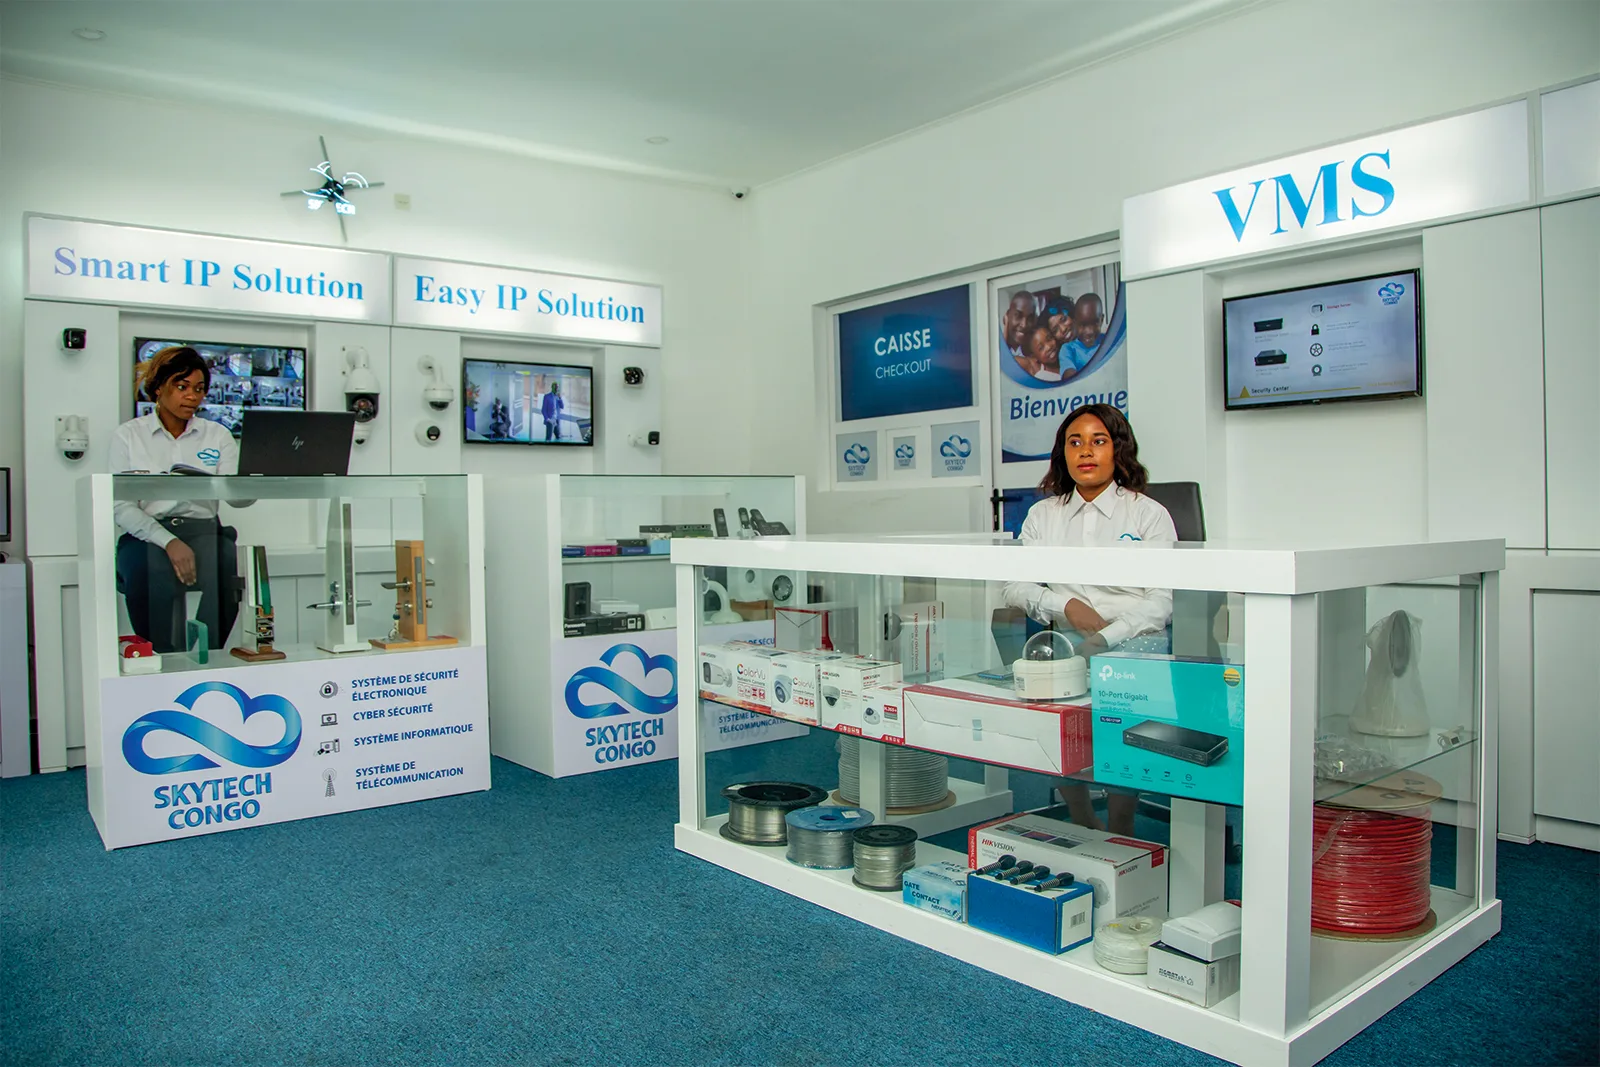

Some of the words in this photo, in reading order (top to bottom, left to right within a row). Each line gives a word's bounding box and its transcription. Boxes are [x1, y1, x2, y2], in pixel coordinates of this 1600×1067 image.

[1212, 148, 1395, 242] VMS
[54, 246, 171, 284] Smart
[182, 258, 221, 287] IP
[232, 263, 365, 301] Solution
[414, 274, 486, 314] Easy
[496, 283, 528, 312] IP
[537, 288, 646, 324] Solution
[874, 328, 932, 357] CAISSE
[875, 358, 932, 379] CHECKOUT
[1251, 387, 1271, 395] Security
[1273, 385, 1290, 393] Center
[1010, 390, 1128, 420] Bienvenue
[351, 671, 396, 690] SYSTÈME
[399, 673, 413, 686] DE
[414, 668, 460, 685] SÉCURITÉ
[737, 663, 766, 680] ColorVu
[1113, 670, 1136, 681] tp-link
[352, 684, 428, 702] ÉLECTRONIQUE
[792, 677, 815, 690] ColorVu
[1097, 689, 1123, 700] 10-Port
[1123, 692, 1149, 703] Gigabit
[1099, 699, 1116, 707] Desktop
[353, 708, 384, 722] CYBER
[387, 702, 434, 719] SÉCURITÉ
[354, 730, 399, 748] SYSTÈME
[401, 723, 474, 742] INFORMATIQUE
[585, 718, 664, 748] SKYTECH
[595, 739, 657, 764] CONGO
[355, 759, 401, 778] SYSTÈME
[402, 760, 416, 772] DE
[356, 766, 464, 791] TÉLÉCOMMUNICATION
[153, 772, 272, 810] SKYTECH
[168, 798, 261, 830] CONGO
[981, 838, 1016, 853] HIKVISION
[1118, 864, 1139, 877] HIKVISION
[903, 880, 920, 891] GATE
[911, 890, 941, 905] CONTACT
[930, 903, 952, 915] NEMTEK
